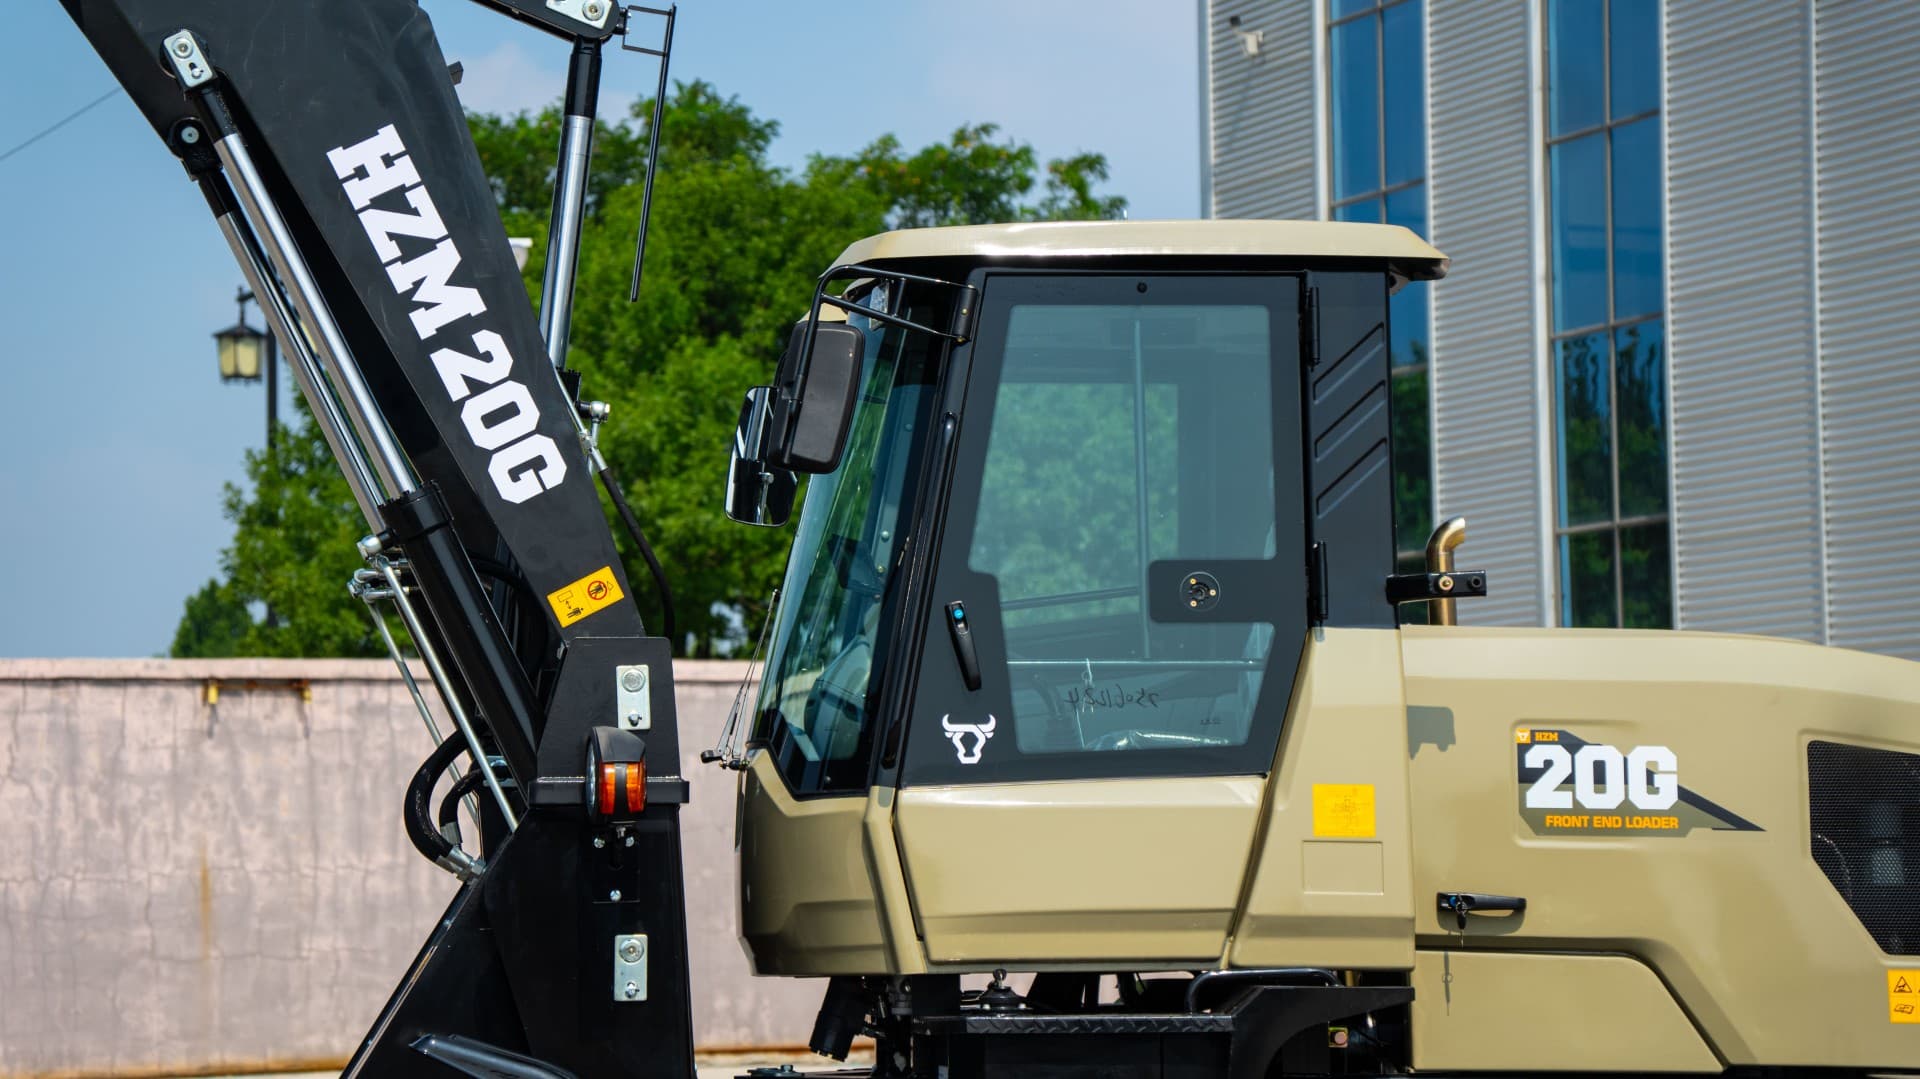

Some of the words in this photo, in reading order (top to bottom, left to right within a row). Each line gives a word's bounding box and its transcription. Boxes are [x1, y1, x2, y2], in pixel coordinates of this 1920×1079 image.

[326, 123, 487, 340] HZM
[430, 329, 567, 504] 20G
[1534, 731, 1559, 742] HZM
[1524, 744, 1678, 810] 20G
[1545, 815, 1590, 828] FRONT
[1593, 816, 1622, 828] END
[1625, 816, 1679, 829] LOADER
